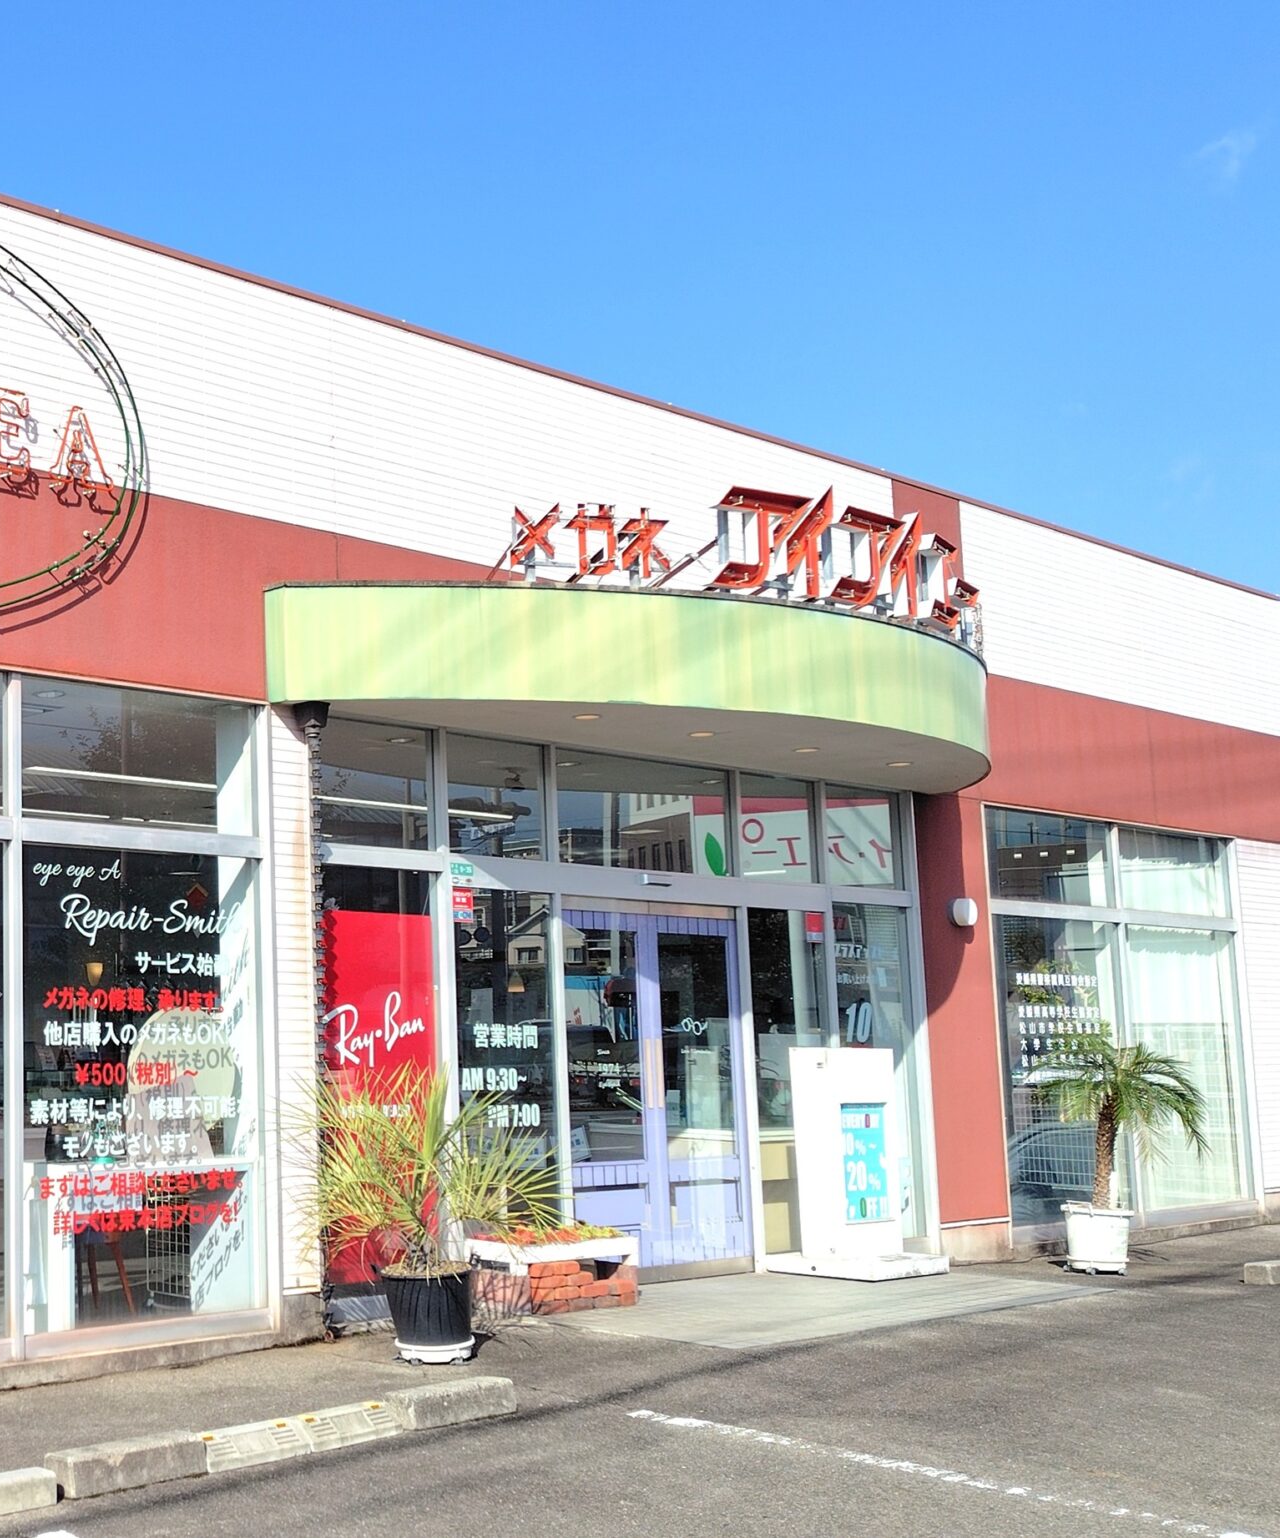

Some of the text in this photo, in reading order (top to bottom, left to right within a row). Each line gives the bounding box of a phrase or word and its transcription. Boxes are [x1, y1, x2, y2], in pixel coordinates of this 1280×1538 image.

[51, 406, 115, 491] A
[509, 502, 671, 578] メガネ
[32, 858, 122, 888] eye eye A
[473, 1023, 539, 1049] 営業時間
[462, 1067, 484, 1091] AM
[487, 1103, 541, 1128] PM 7:00
[62, 1131, 198, 1158] モノもございます。
[39, 1167, 243, 1200] まずはご相談くださいませ。
